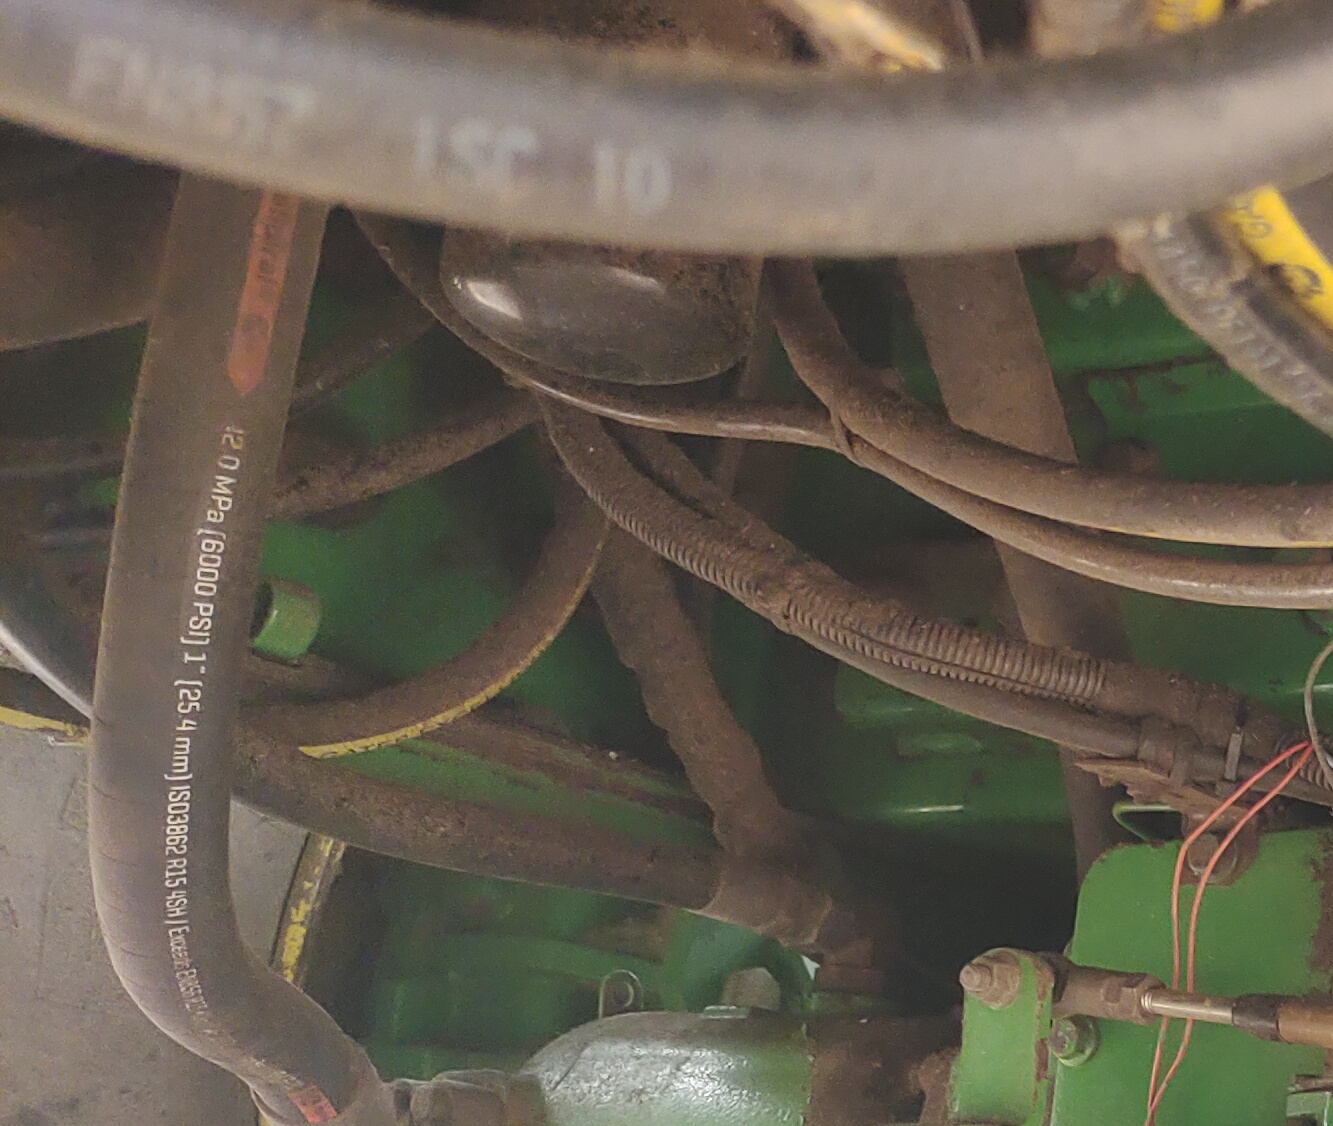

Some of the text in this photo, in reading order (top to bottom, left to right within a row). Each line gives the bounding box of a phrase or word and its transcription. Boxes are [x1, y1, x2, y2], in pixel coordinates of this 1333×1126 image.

[206, 475, 237, 523] MPa
[194, 528, 227, 597] (6000
[180, 602, 215, 645] PSI)
[163, 737, 193, 780] mm)
[165, 785, 191, 857] ISO3862
[165, 857, 188, 888] R15
[165, 890, 188, 918] 4SH
